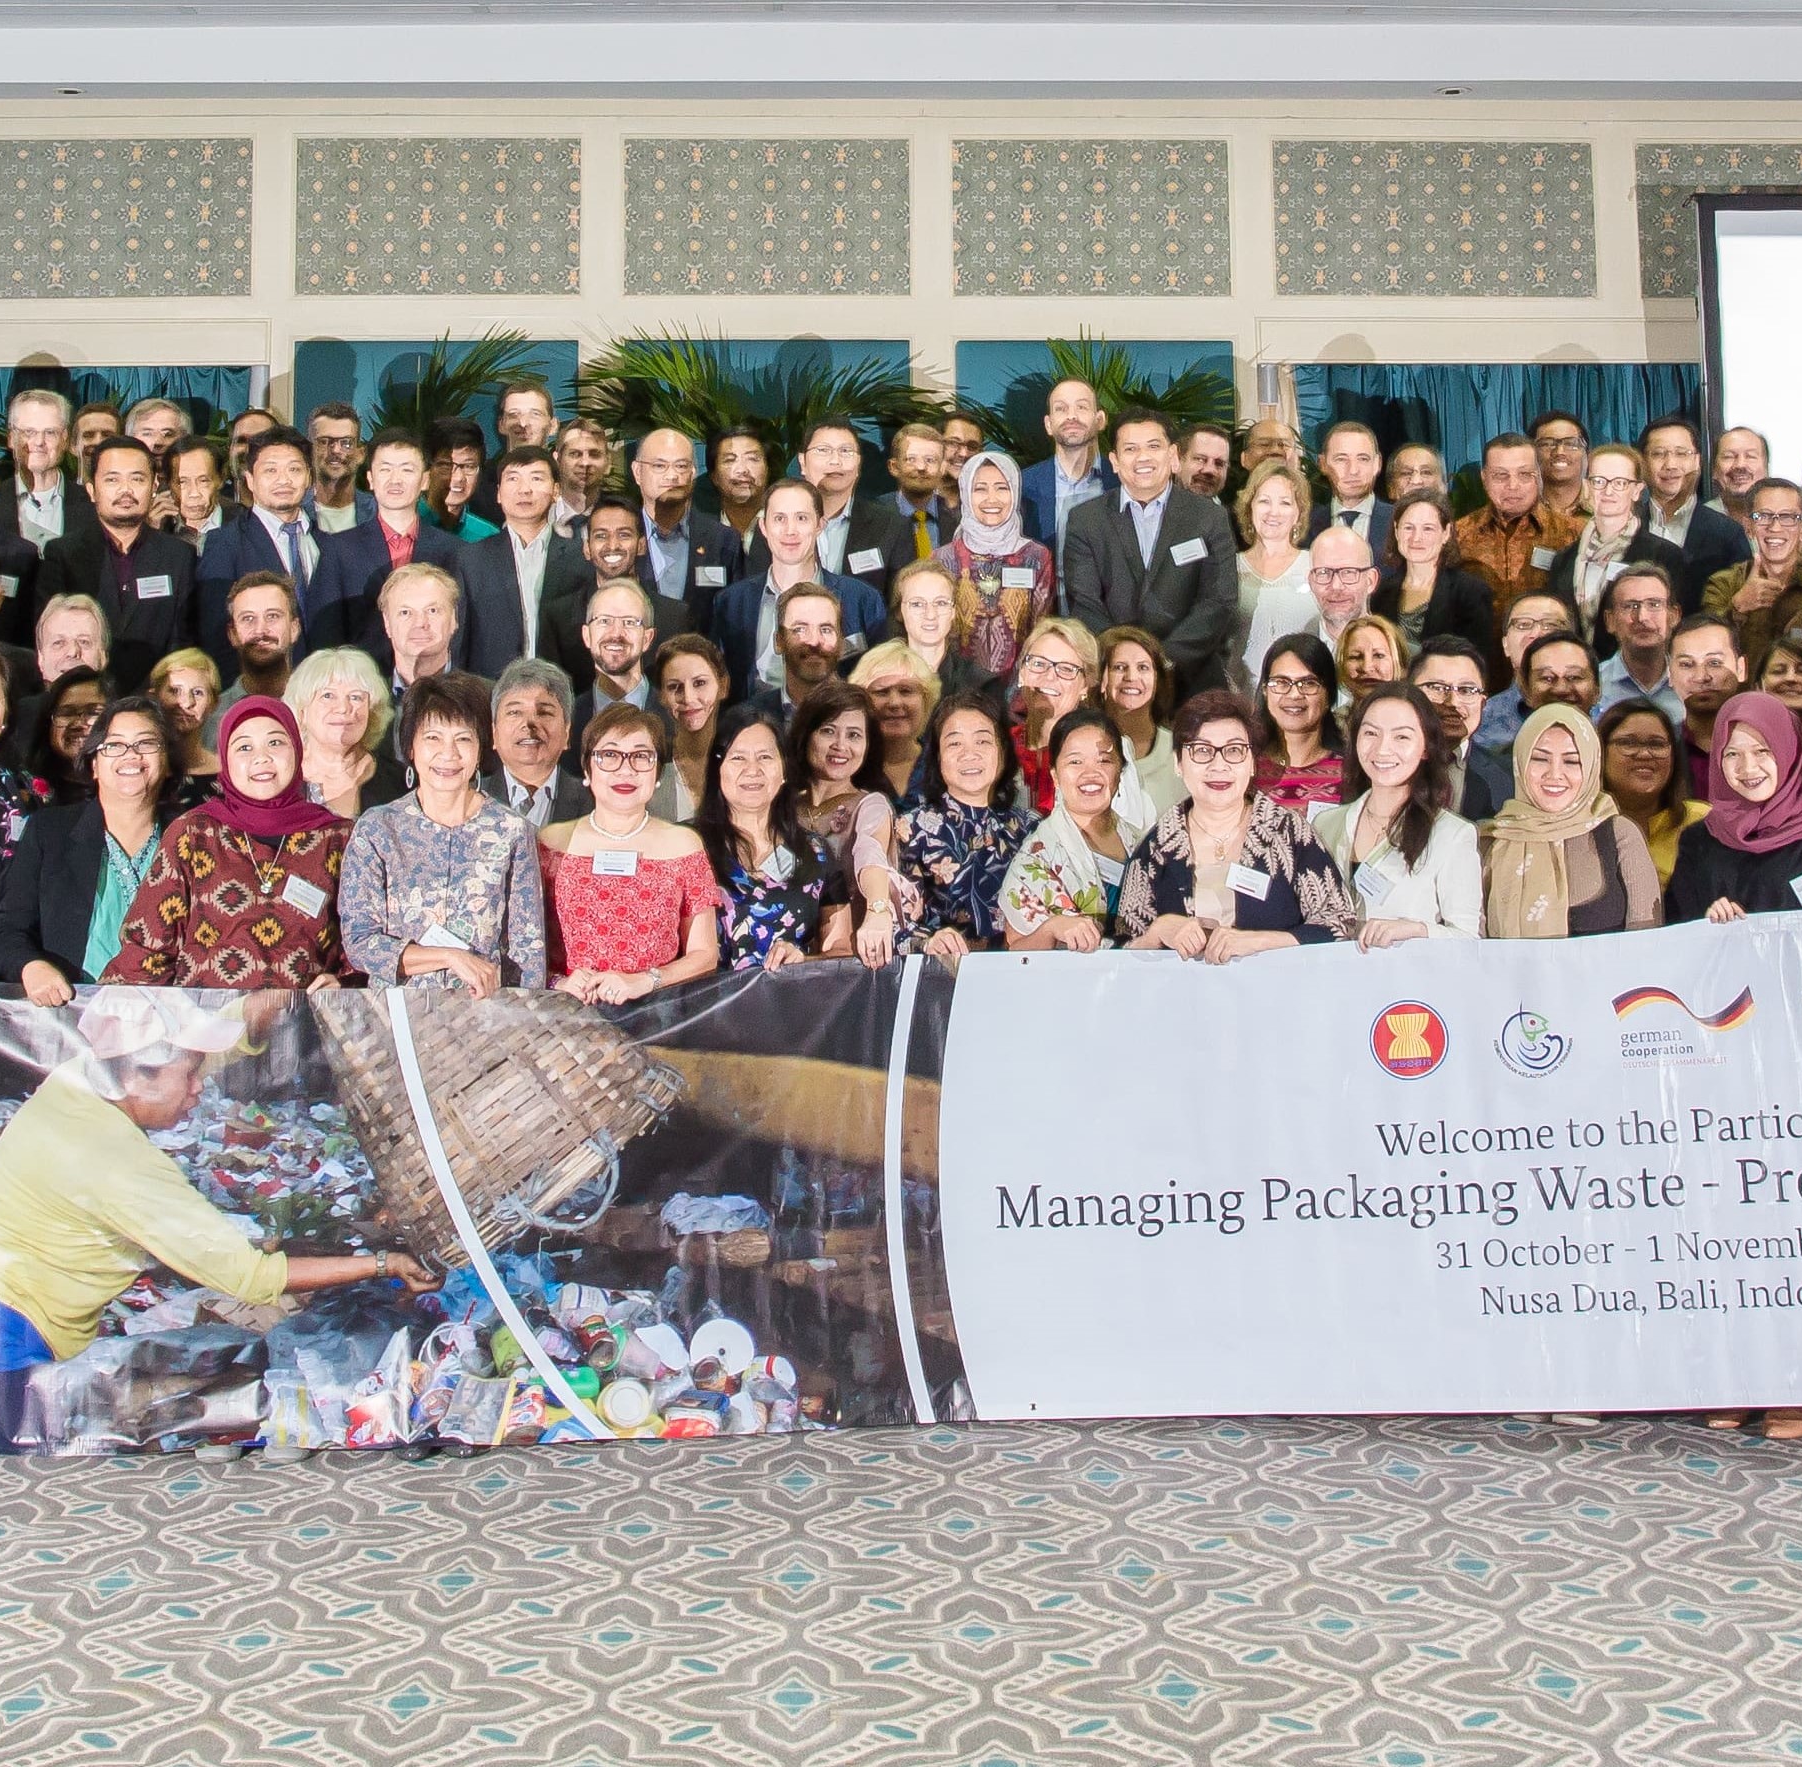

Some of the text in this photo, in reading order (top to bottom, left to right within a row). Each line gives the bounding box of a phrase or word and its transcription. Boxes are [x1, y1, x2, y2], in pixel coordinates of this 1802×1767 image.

[1620, 1029, 1683, 1048] german
[1621, 1043, 1694, 1059] cooperation
[1375, 1119, 1555, 1157] Welcome
[1565, 1117, 1605, 1149] to
[1615, 1108, 1678, 1147] the
[995, 1179, 1245, 1238] Managing
[1260, 1171, 1519, 1229] Packaging
[1527, 1164, 1686, 1213] Waste
[1435, 1241, 1471, 1270] 31
[1482, 1236, 1615, 1269] October
[1646, 1235, 1665, 1263] 1
[1480, 1286, 1564, 1316] Nusa
[1572, 1284, 1647, 1317] Dua,
[1656, 1278, 1729, 1314] Bali,
